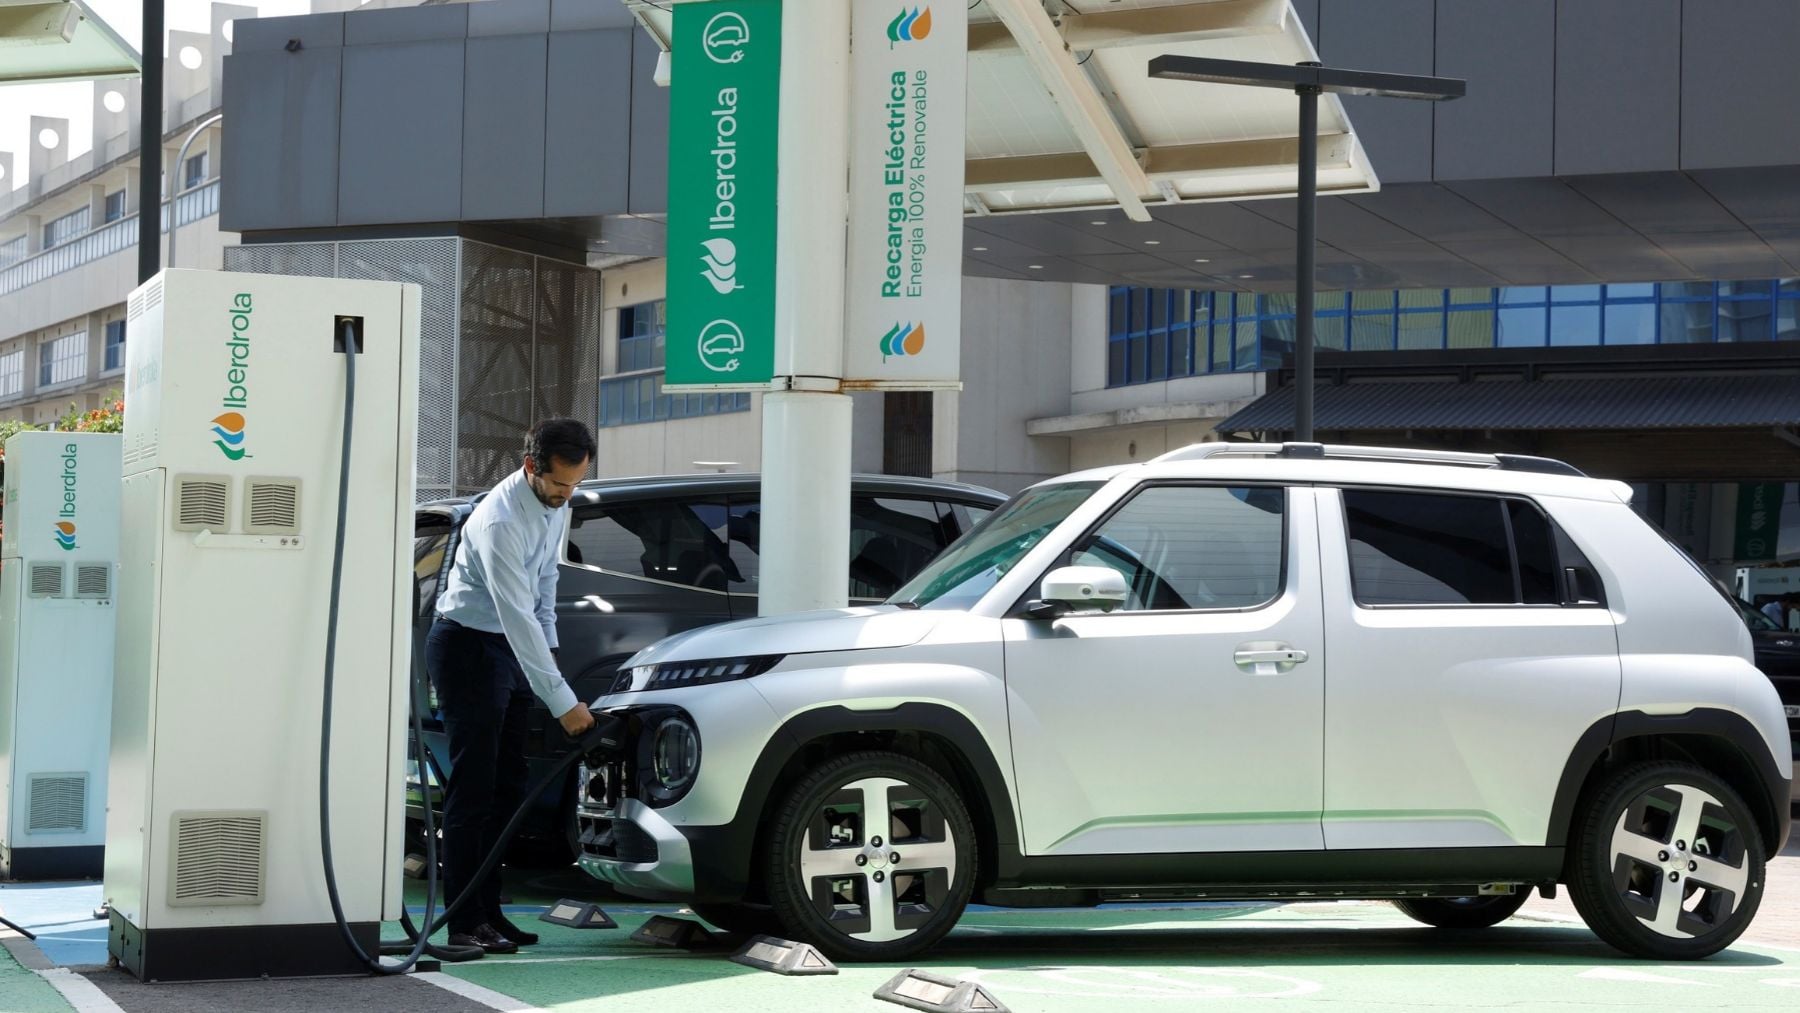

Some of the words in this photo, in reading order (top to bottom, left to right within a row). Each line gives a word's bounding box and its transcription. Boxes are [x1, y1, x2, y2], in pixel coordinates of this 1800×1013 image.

[709, 87, 738, 230] Iberdrola
[885, 71, 906, 185] Eléctrica
[910, 70, 927, 169] Renovable
[881, 192, 907, 297] Recarga
[908, 174, 925, 222] 100%
[223, 293, 252, 408] Iberdrola
[59, 443, 77, 517] Iberdrola
